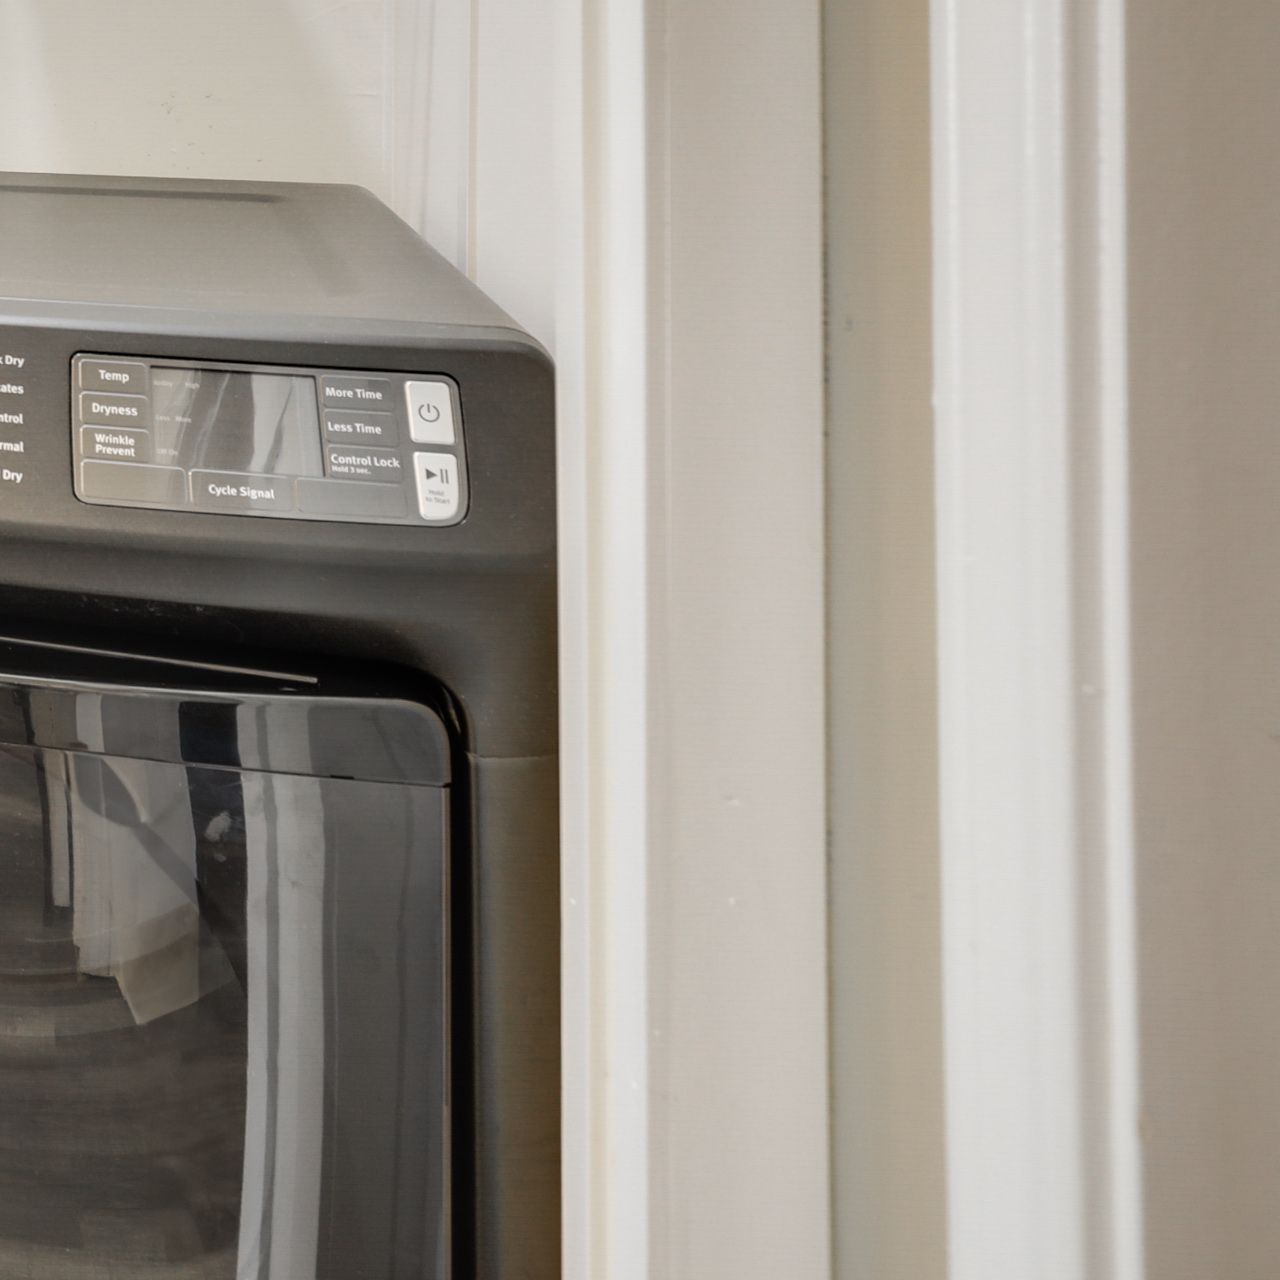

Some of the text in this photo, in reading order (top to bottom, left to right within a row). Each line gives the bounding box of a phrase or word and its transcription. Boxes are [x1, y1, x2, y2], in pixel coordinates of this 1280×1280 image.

[5, 355, 25, 368] Dry
[98, 369, 130, 384] Temp
[325, 386, 383, 400] More Time
[91, 402, 138, 416] Dryness
[327, 421, 383, 435] Less Time
[94, 433, 135, 446] Wrinkle
[95, 444, 135, 457] Prevent
[330, 453, 400, 468] Control Lock
[2, 469, 23, 483] Dry
[208, 484, 275, 500] Cycle Signal
